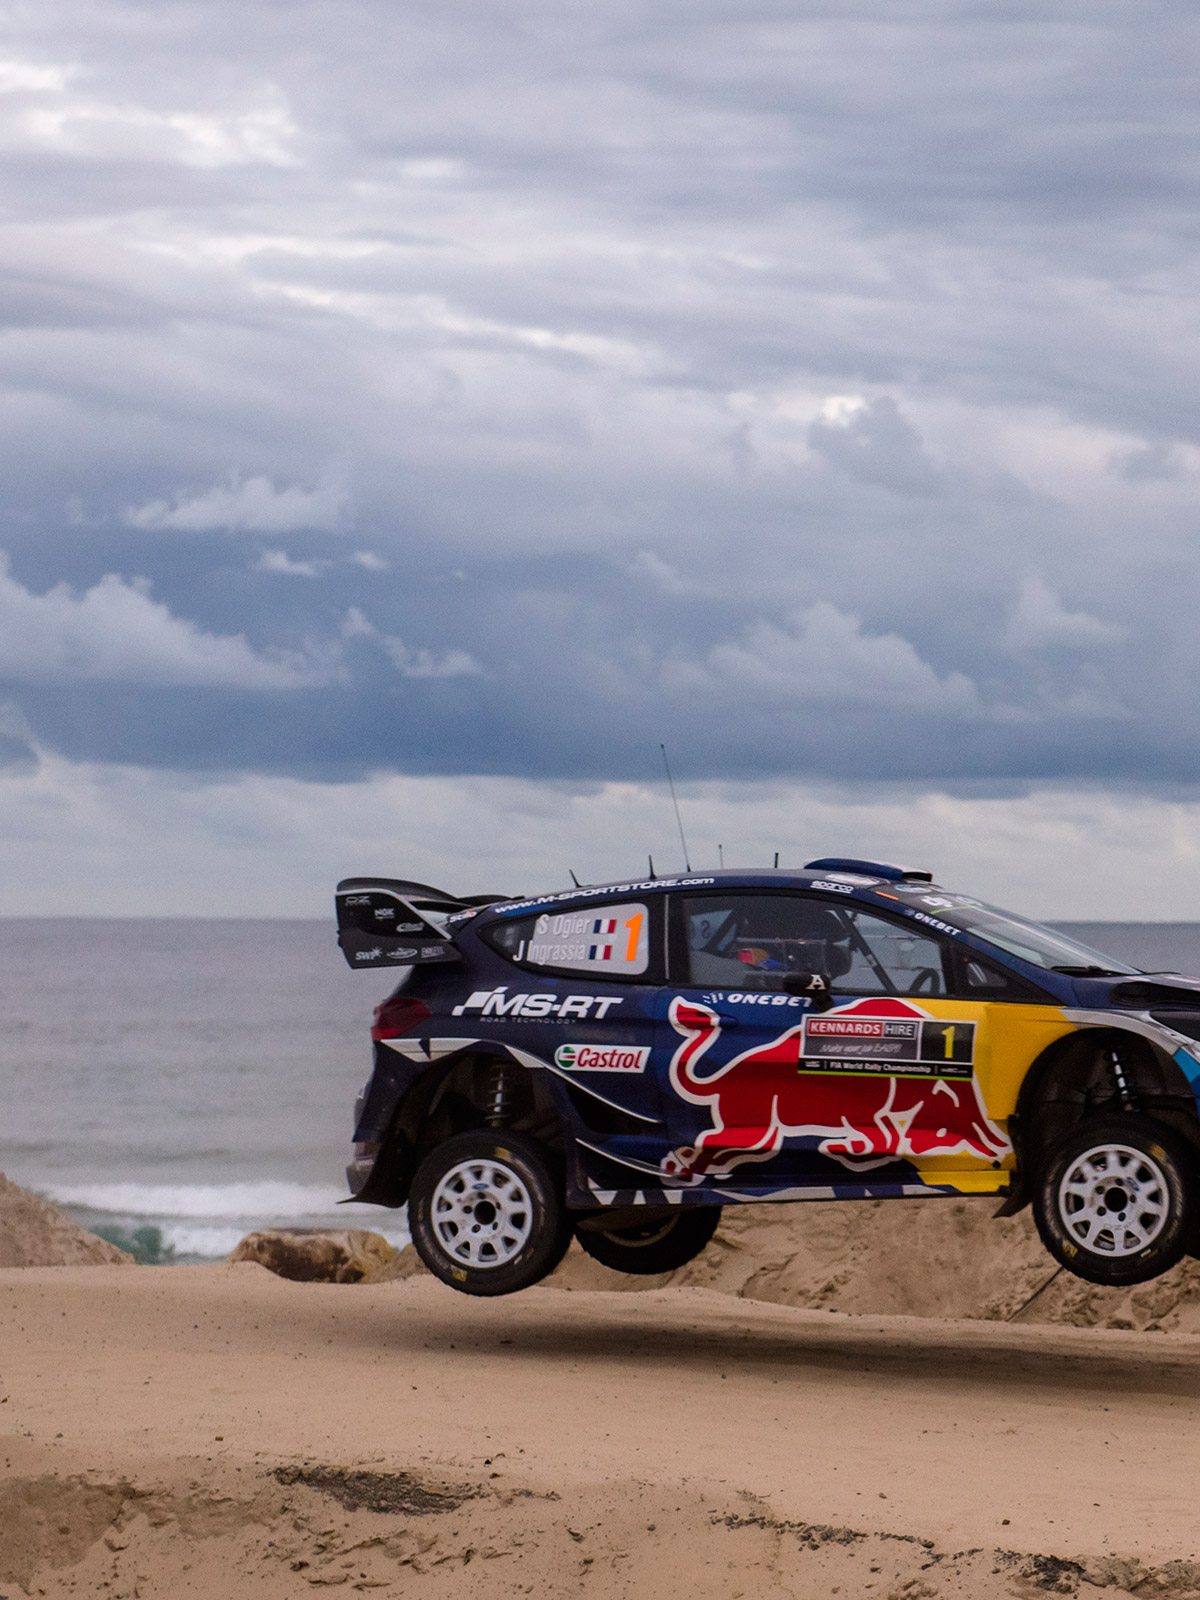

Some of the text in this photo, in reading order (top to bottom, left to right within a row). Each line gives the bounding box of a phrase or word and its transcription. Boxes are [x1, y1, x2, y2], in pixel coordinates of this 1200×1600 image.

[537, 913, 591, 939] S Ogier
[914, 912, 962, 936] ONEBET
[625, 913, 643, 961] 1
[512, 940, 586, 965] J Ingrassia
[511, 1017, 578, 1025] TECHNOLOGY
[810, 1021, 913, 1036] KENNARDS HIRE
[941, 1025, 955, 1059] 1
[577, 1047, 643, 1069] Castrol
[830, 1061, 842, 1069] FIA
[843, 1062, 864, 1070] World
[864, 1063, 882, 1072] Rally
[883, 1064, 931, 1074] Championship
